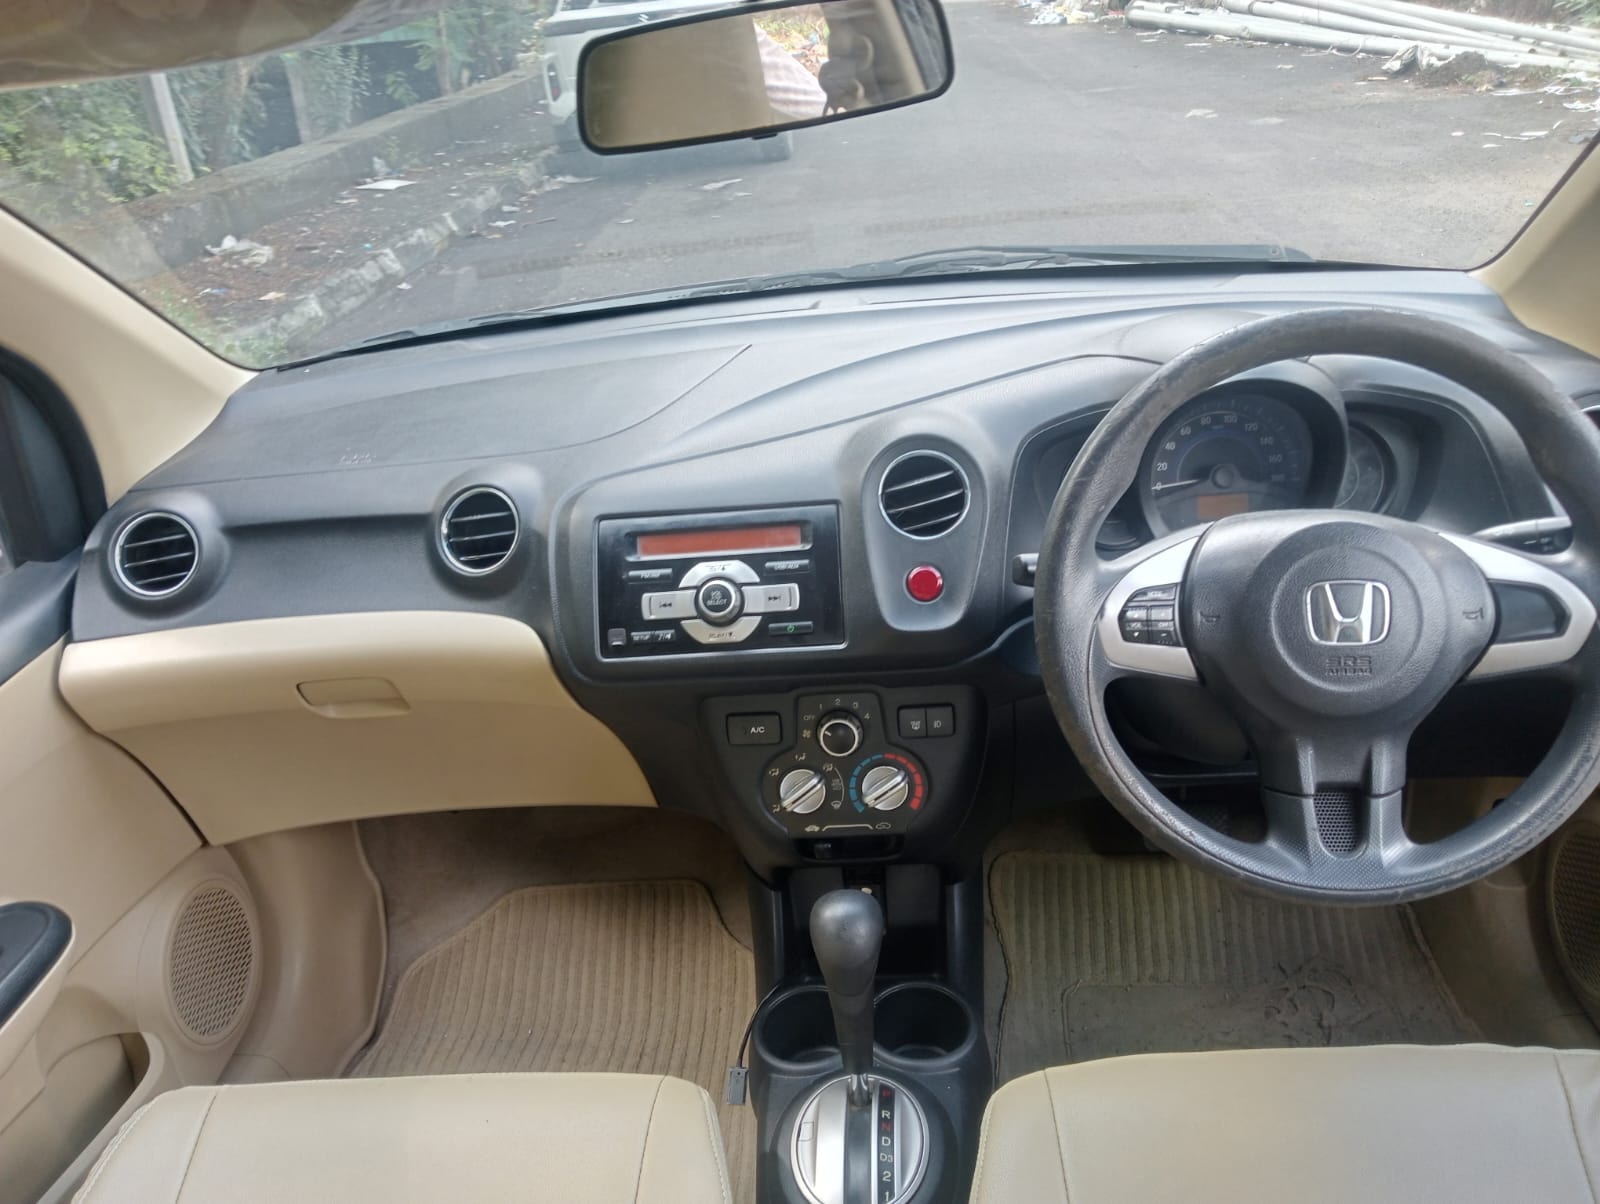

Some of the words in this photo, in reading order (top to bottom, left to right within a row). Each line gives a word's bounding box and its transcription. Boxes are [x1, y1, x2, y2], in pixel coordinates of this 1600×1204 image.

[1223, 414, 1238, 424] 100
[1180, 426, 1191, 436] 60
[1244, 423, 1259, 432] 120
[1165, 441, 1176, 450] 40
[1156, 462, 1168, 471] 20
[1326, 654, 1373, 667] SRS
[819, 703, 824, 711] 1
[834, 698, 842, 706] 2
[852, 701, 859, 709] 3
[863, 712, 871, 720] 4
[750, 725, 766, 735] A/C
[881, 1110, 891, 1120] R
[882, 1122, 892, 1131] N
[881, 1136, 892, 1146] D
[880, 1152, 894, 1163] D3
[882, 1170, 892, 1182] 2
[884, 1191, 890, 1202] 1
